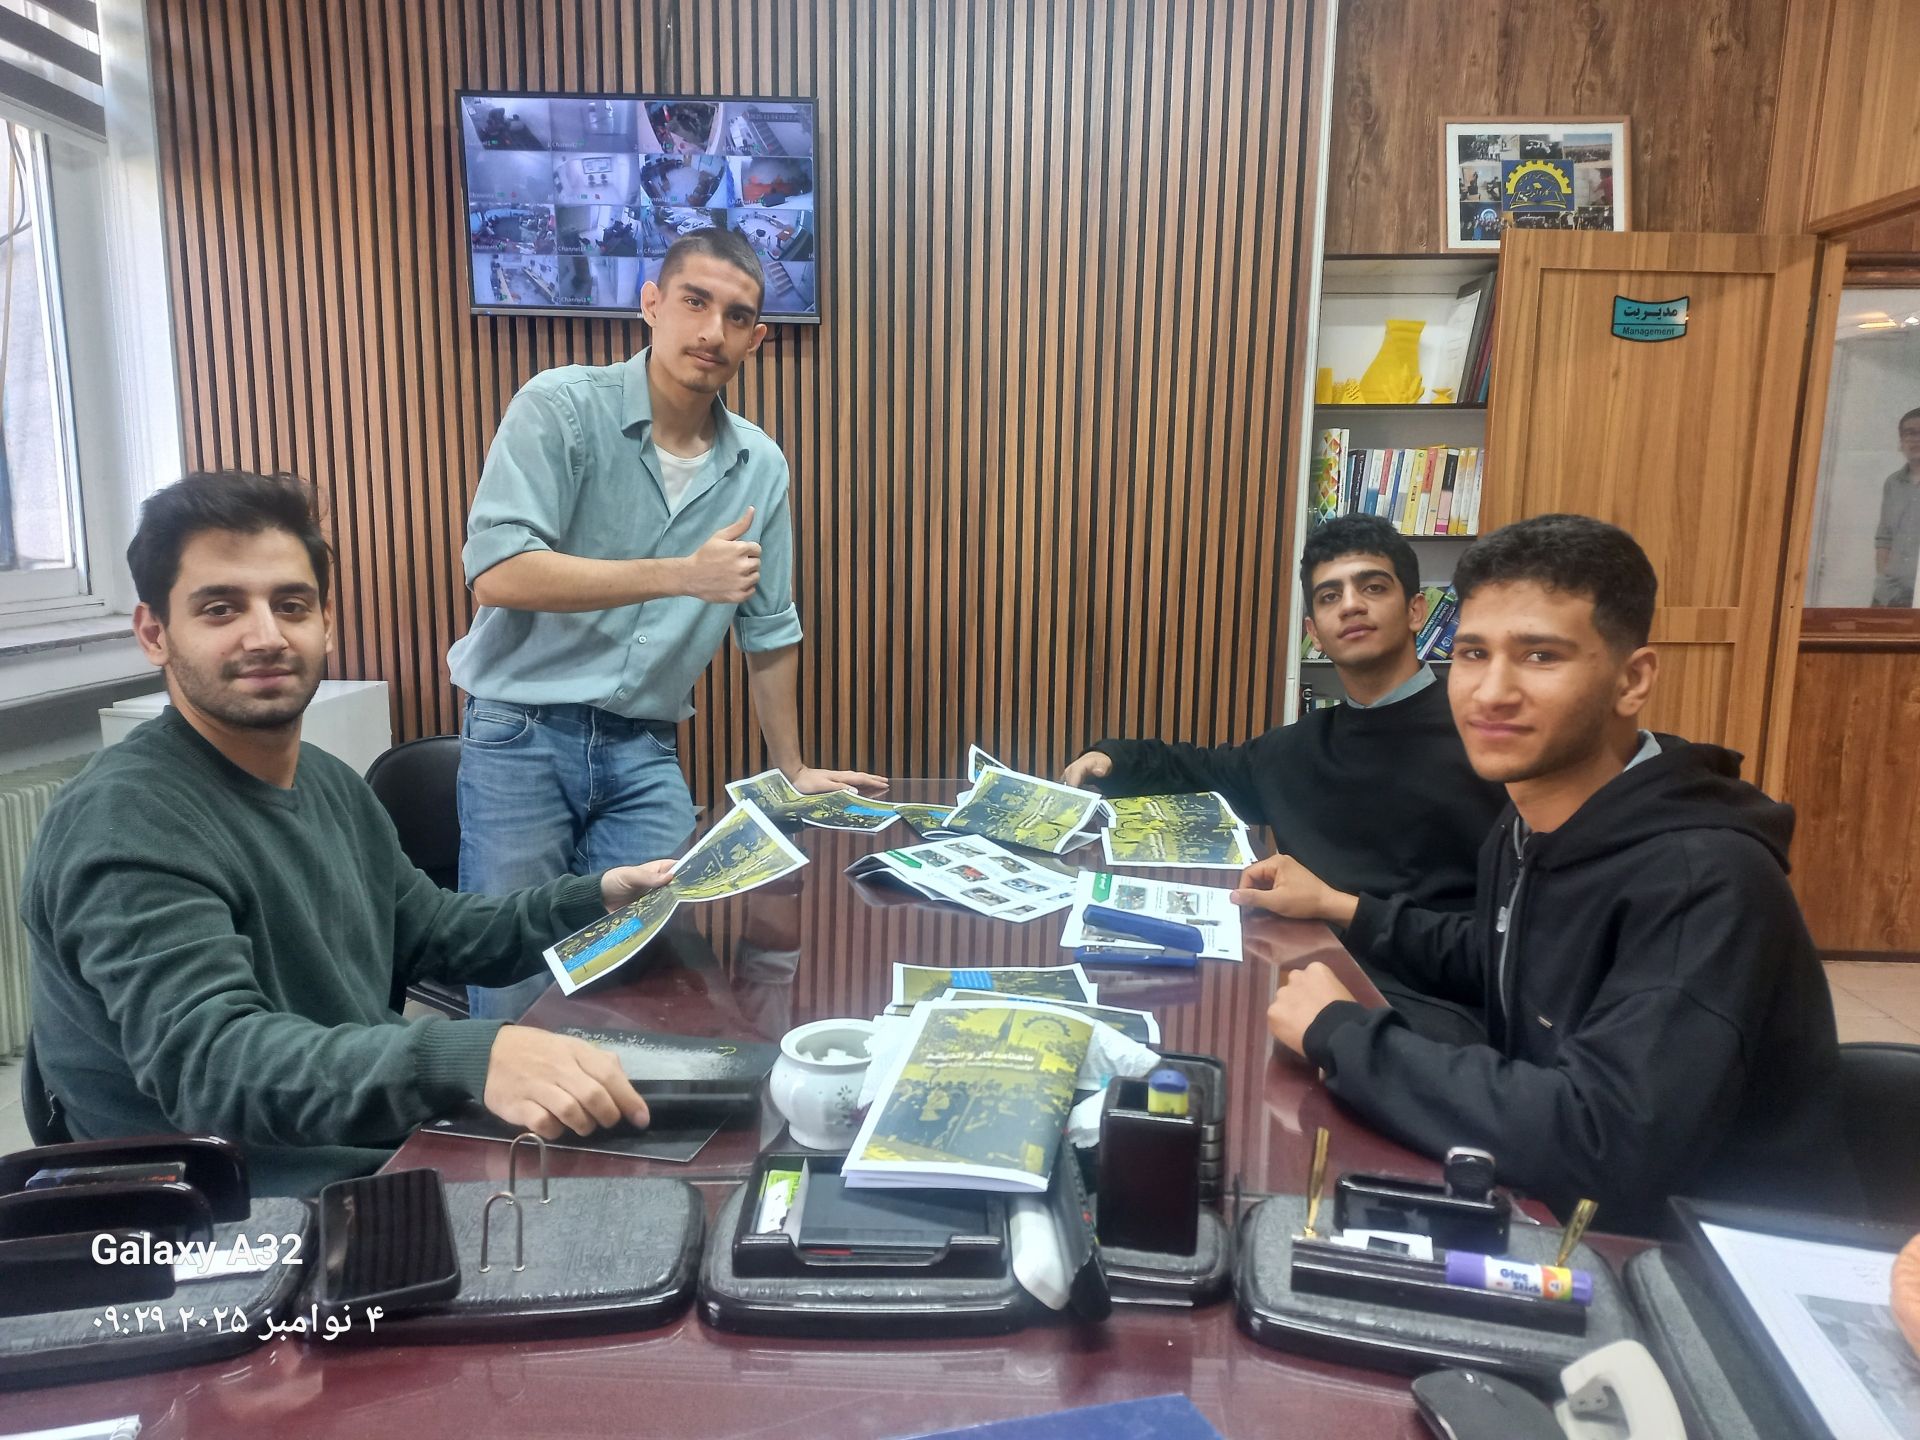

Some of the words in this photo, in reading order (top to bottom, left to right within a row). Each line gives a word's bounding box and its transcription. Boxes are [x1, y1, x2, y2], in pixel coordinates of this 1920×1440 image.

[1623, 306, 1678, 321] مدیریت
[1622, 326, 1675, 337] Management
[1500, 1268, 1528, 1281] Glue
[1512, 1281, 1541, 1293] Stick
